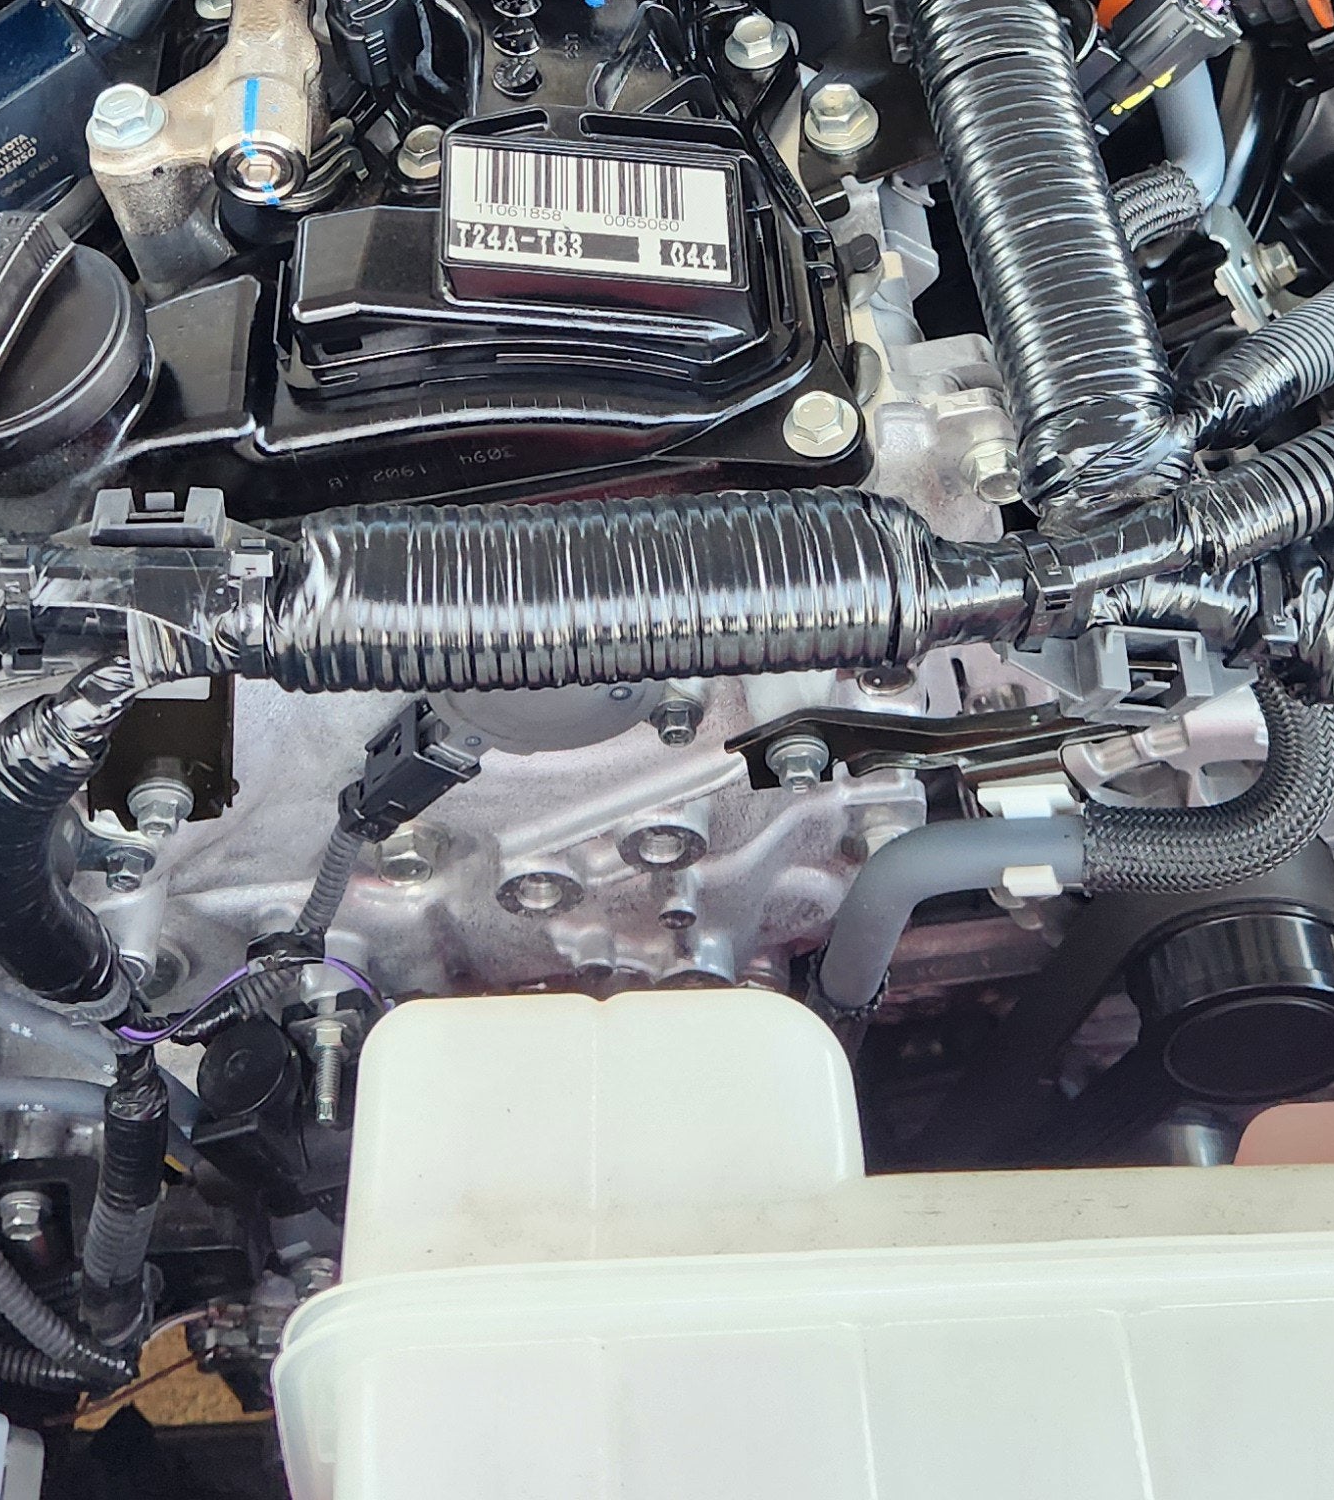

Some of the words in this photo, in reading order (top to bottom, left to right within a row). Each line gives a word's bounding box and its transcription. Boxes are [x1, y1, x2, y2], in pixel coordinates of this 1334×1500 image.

[477, 203, 562, 222] 11061858
[604, 214, 680, 233] 0065060
[670, 241, 718, 270] 044
